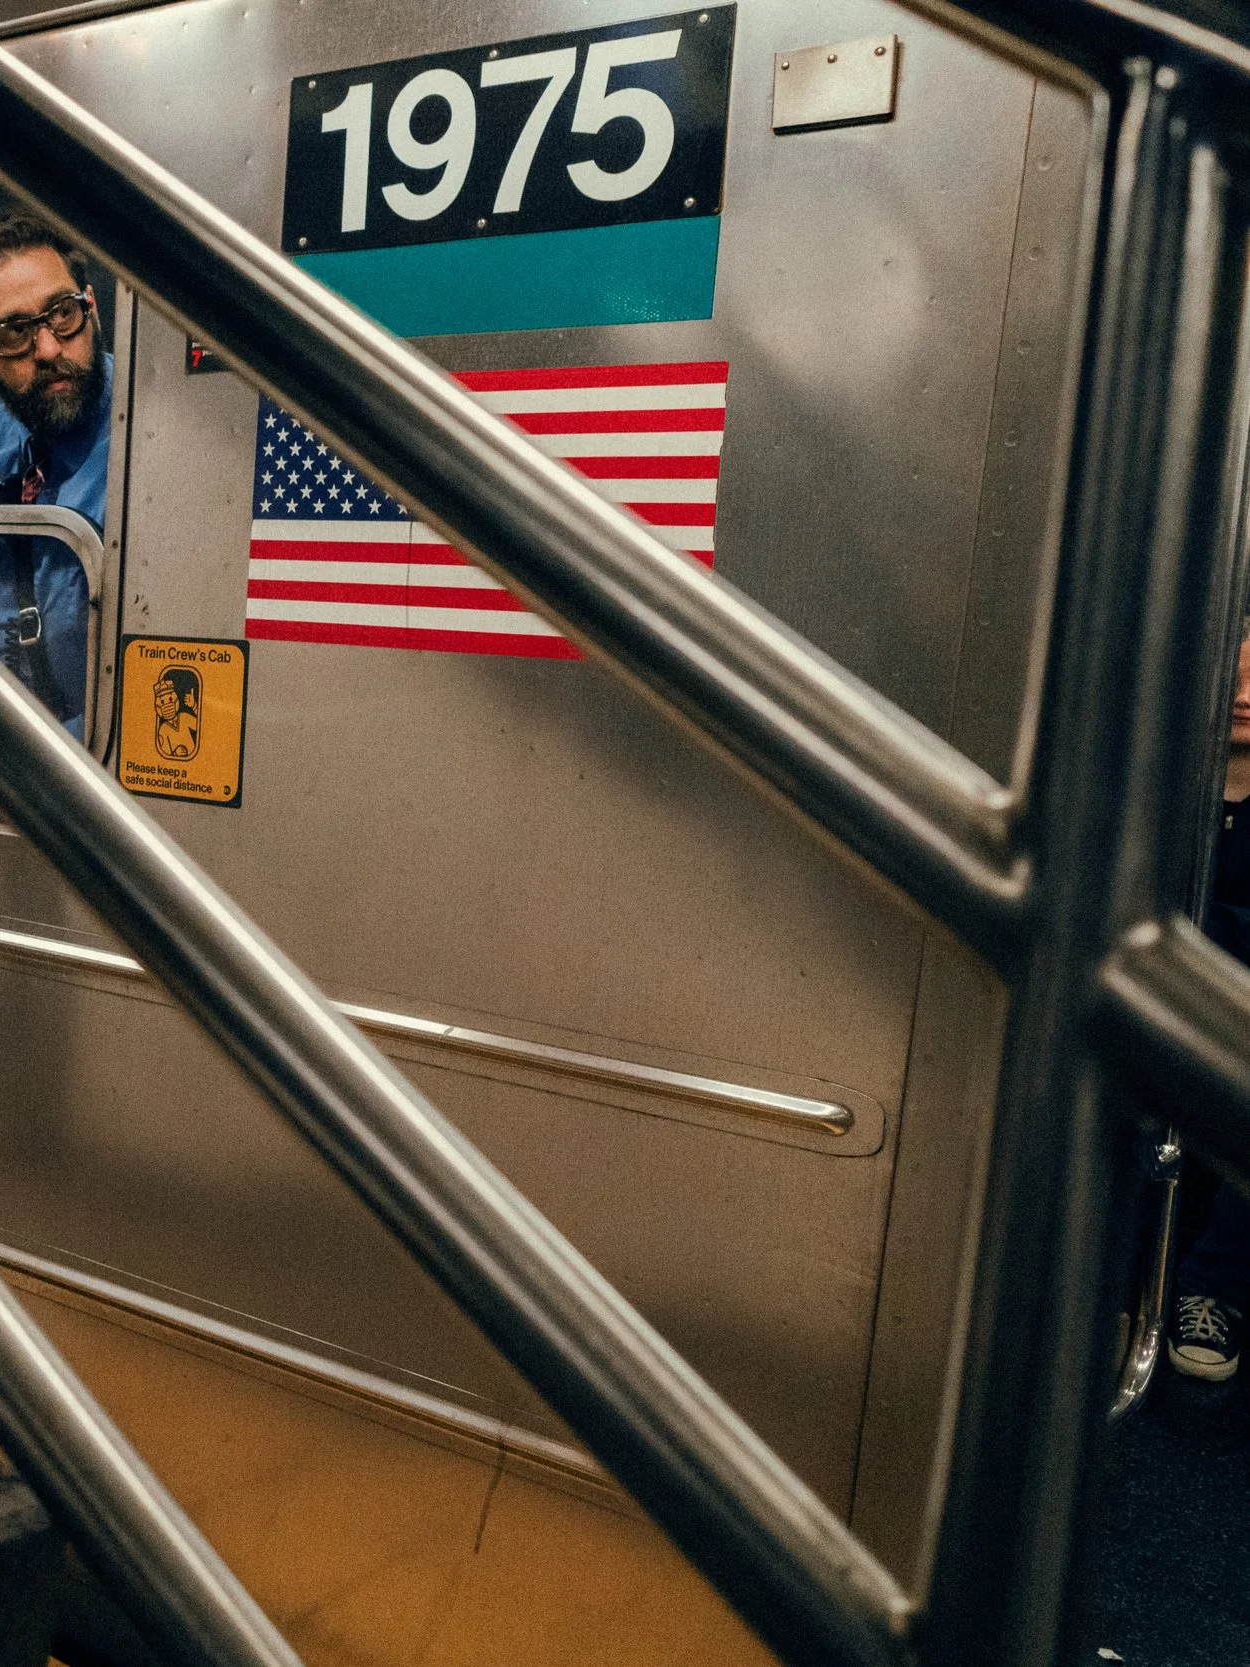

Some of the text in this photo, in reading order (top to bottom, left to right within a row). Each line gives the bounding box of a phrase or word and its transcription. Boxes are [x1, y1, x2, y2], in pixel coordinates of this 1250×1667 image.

[321, 29, 682, 233] 1975
[138, 645, 231, 663] Train Crew's Cab
[126, 761, 187, 779] Please keep a
[125, 775, 144, 785] safe
[145, 777, 172, 788] social
[173, 779, 212, 793] distance
